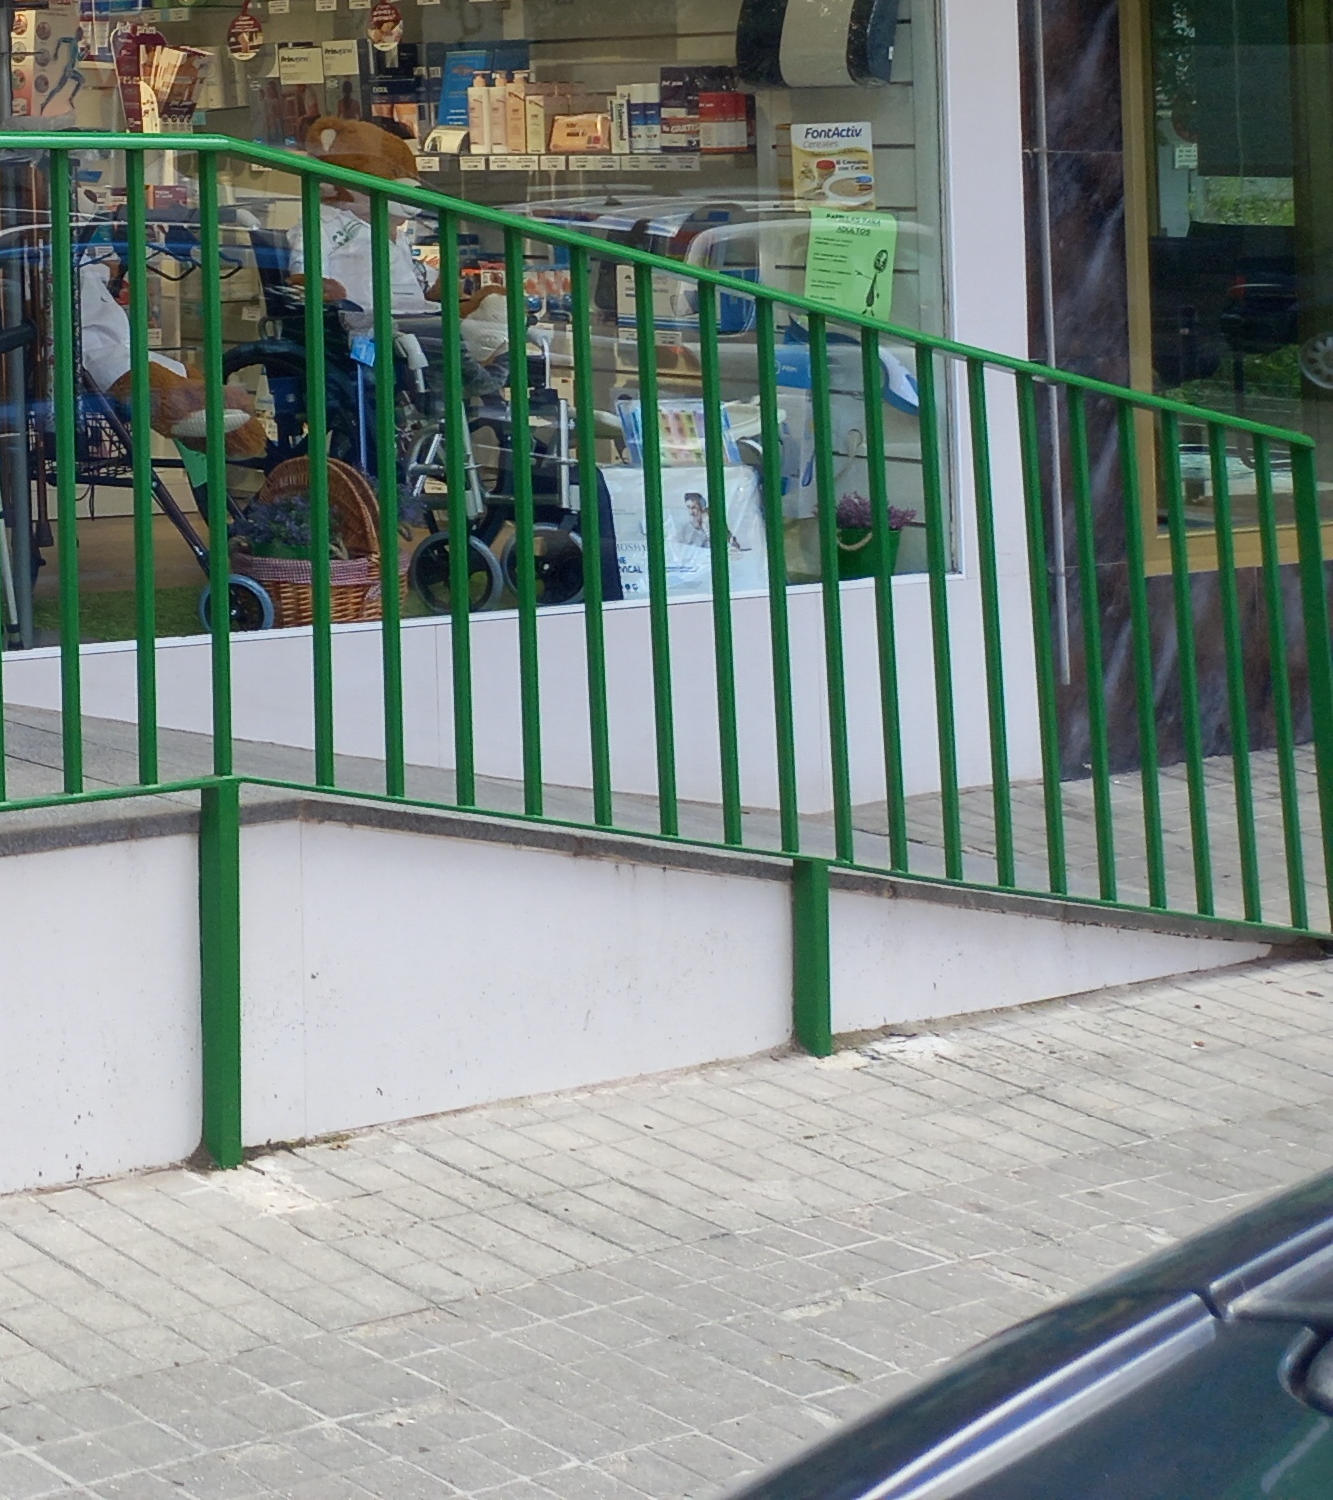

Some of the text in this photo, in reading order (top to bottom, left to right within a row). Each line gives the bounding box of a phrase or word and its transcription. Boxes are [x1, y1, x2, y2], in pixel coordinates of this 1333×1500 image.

[804, 125, 863, 140] FontActiv
[802, 140, 839, 150] Cereales
[836, 226, 871, 236] ADULTOS
